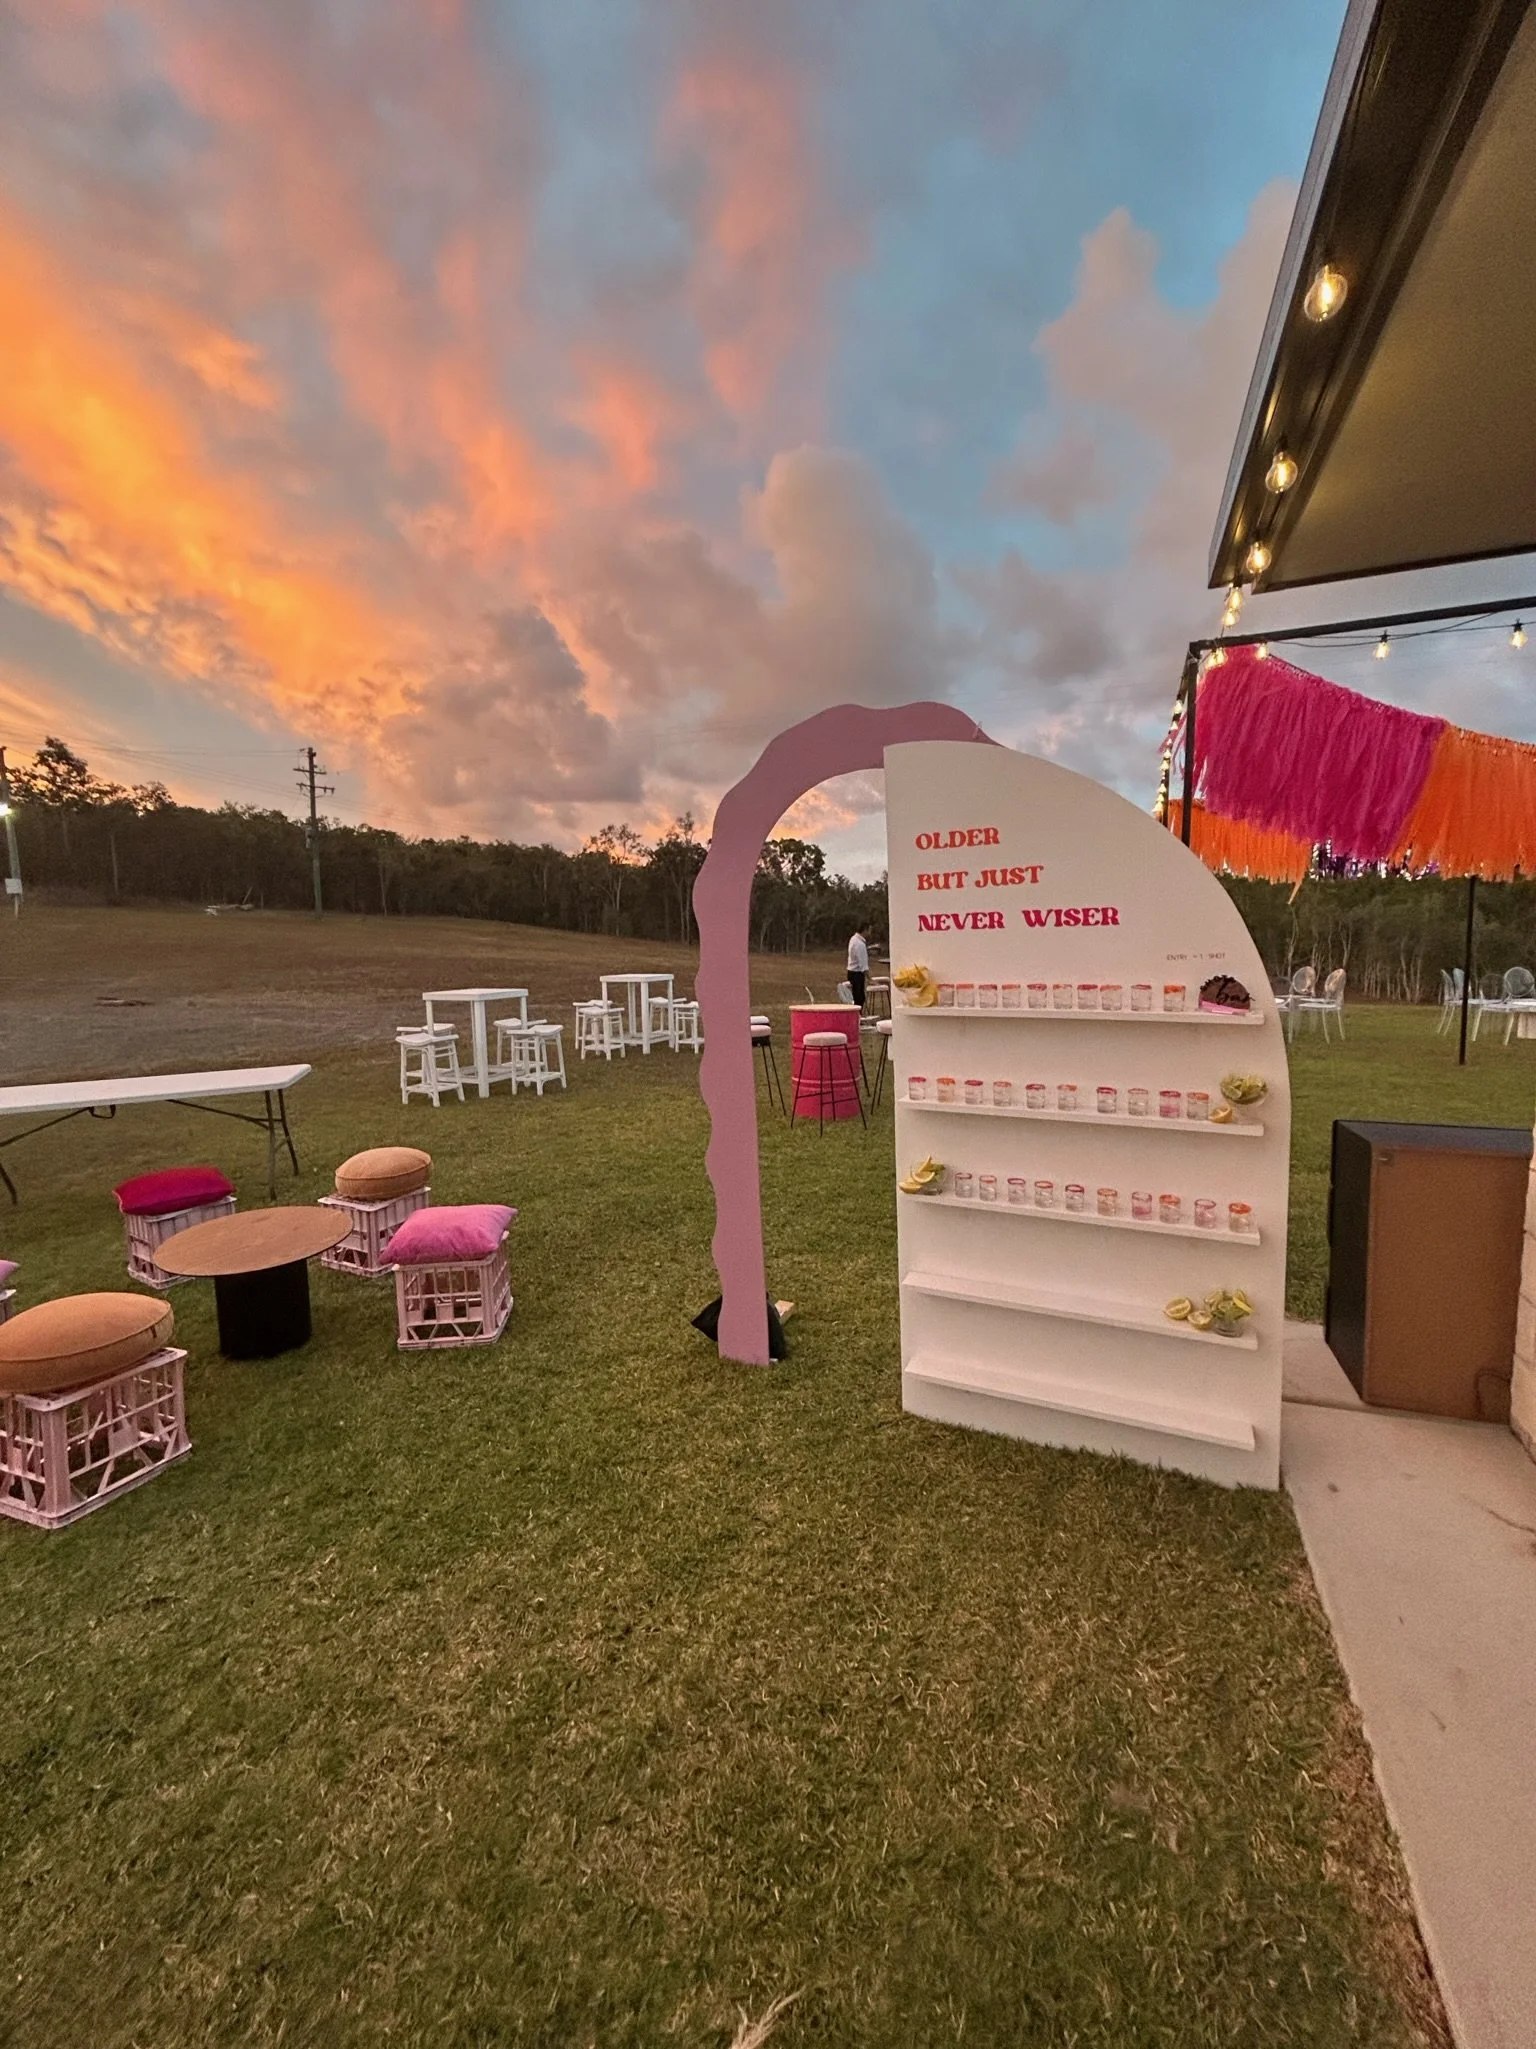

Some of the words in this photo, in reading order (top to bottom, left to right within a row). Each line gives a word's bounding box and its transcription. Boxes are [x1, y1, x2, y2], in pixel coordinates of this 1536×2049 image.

[915, 827, 1000, 850] OLDER
[917, 870, 968, 890] BUT
[975, 865, 1044, 888] JUST
[918, 911, 1005, 932] NEVER
[1022, 906, 1120, 928] WISER
